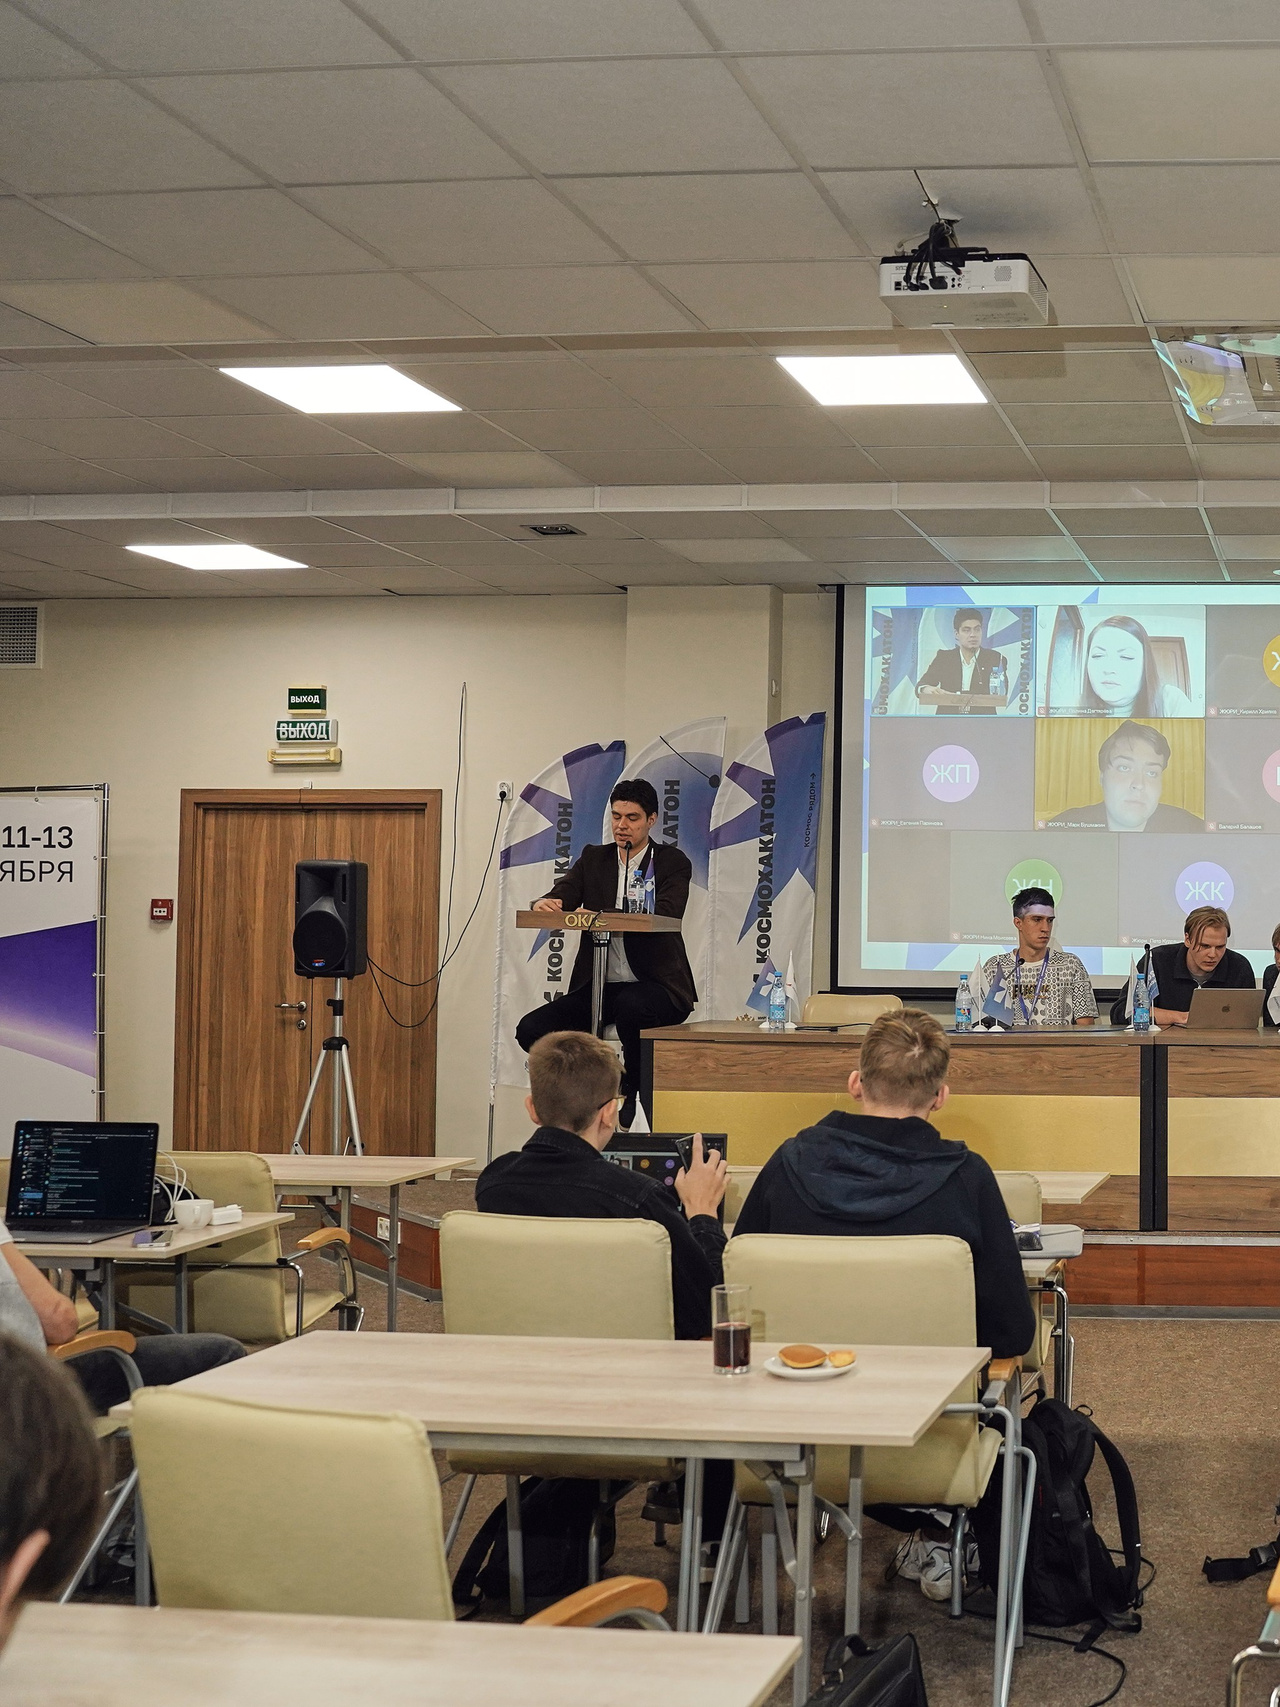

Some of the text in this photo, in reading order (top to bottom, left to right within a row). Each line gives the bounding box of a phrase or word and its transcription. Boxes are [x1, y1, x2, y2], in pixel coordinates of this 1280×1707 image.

[290, 695, 320, 704] ВЫХОД
[279, 722, 328, 740] ВЫХОД
[929, 764, 970, 783] ЖП
[2, 825, 73, 849] 11-13
[0, 860, 73, 883] ЯБРЯ
[756, 778, 776, 964] КОСМОХАКАТОН
[1184, 881, 1225, 901] ЖК
